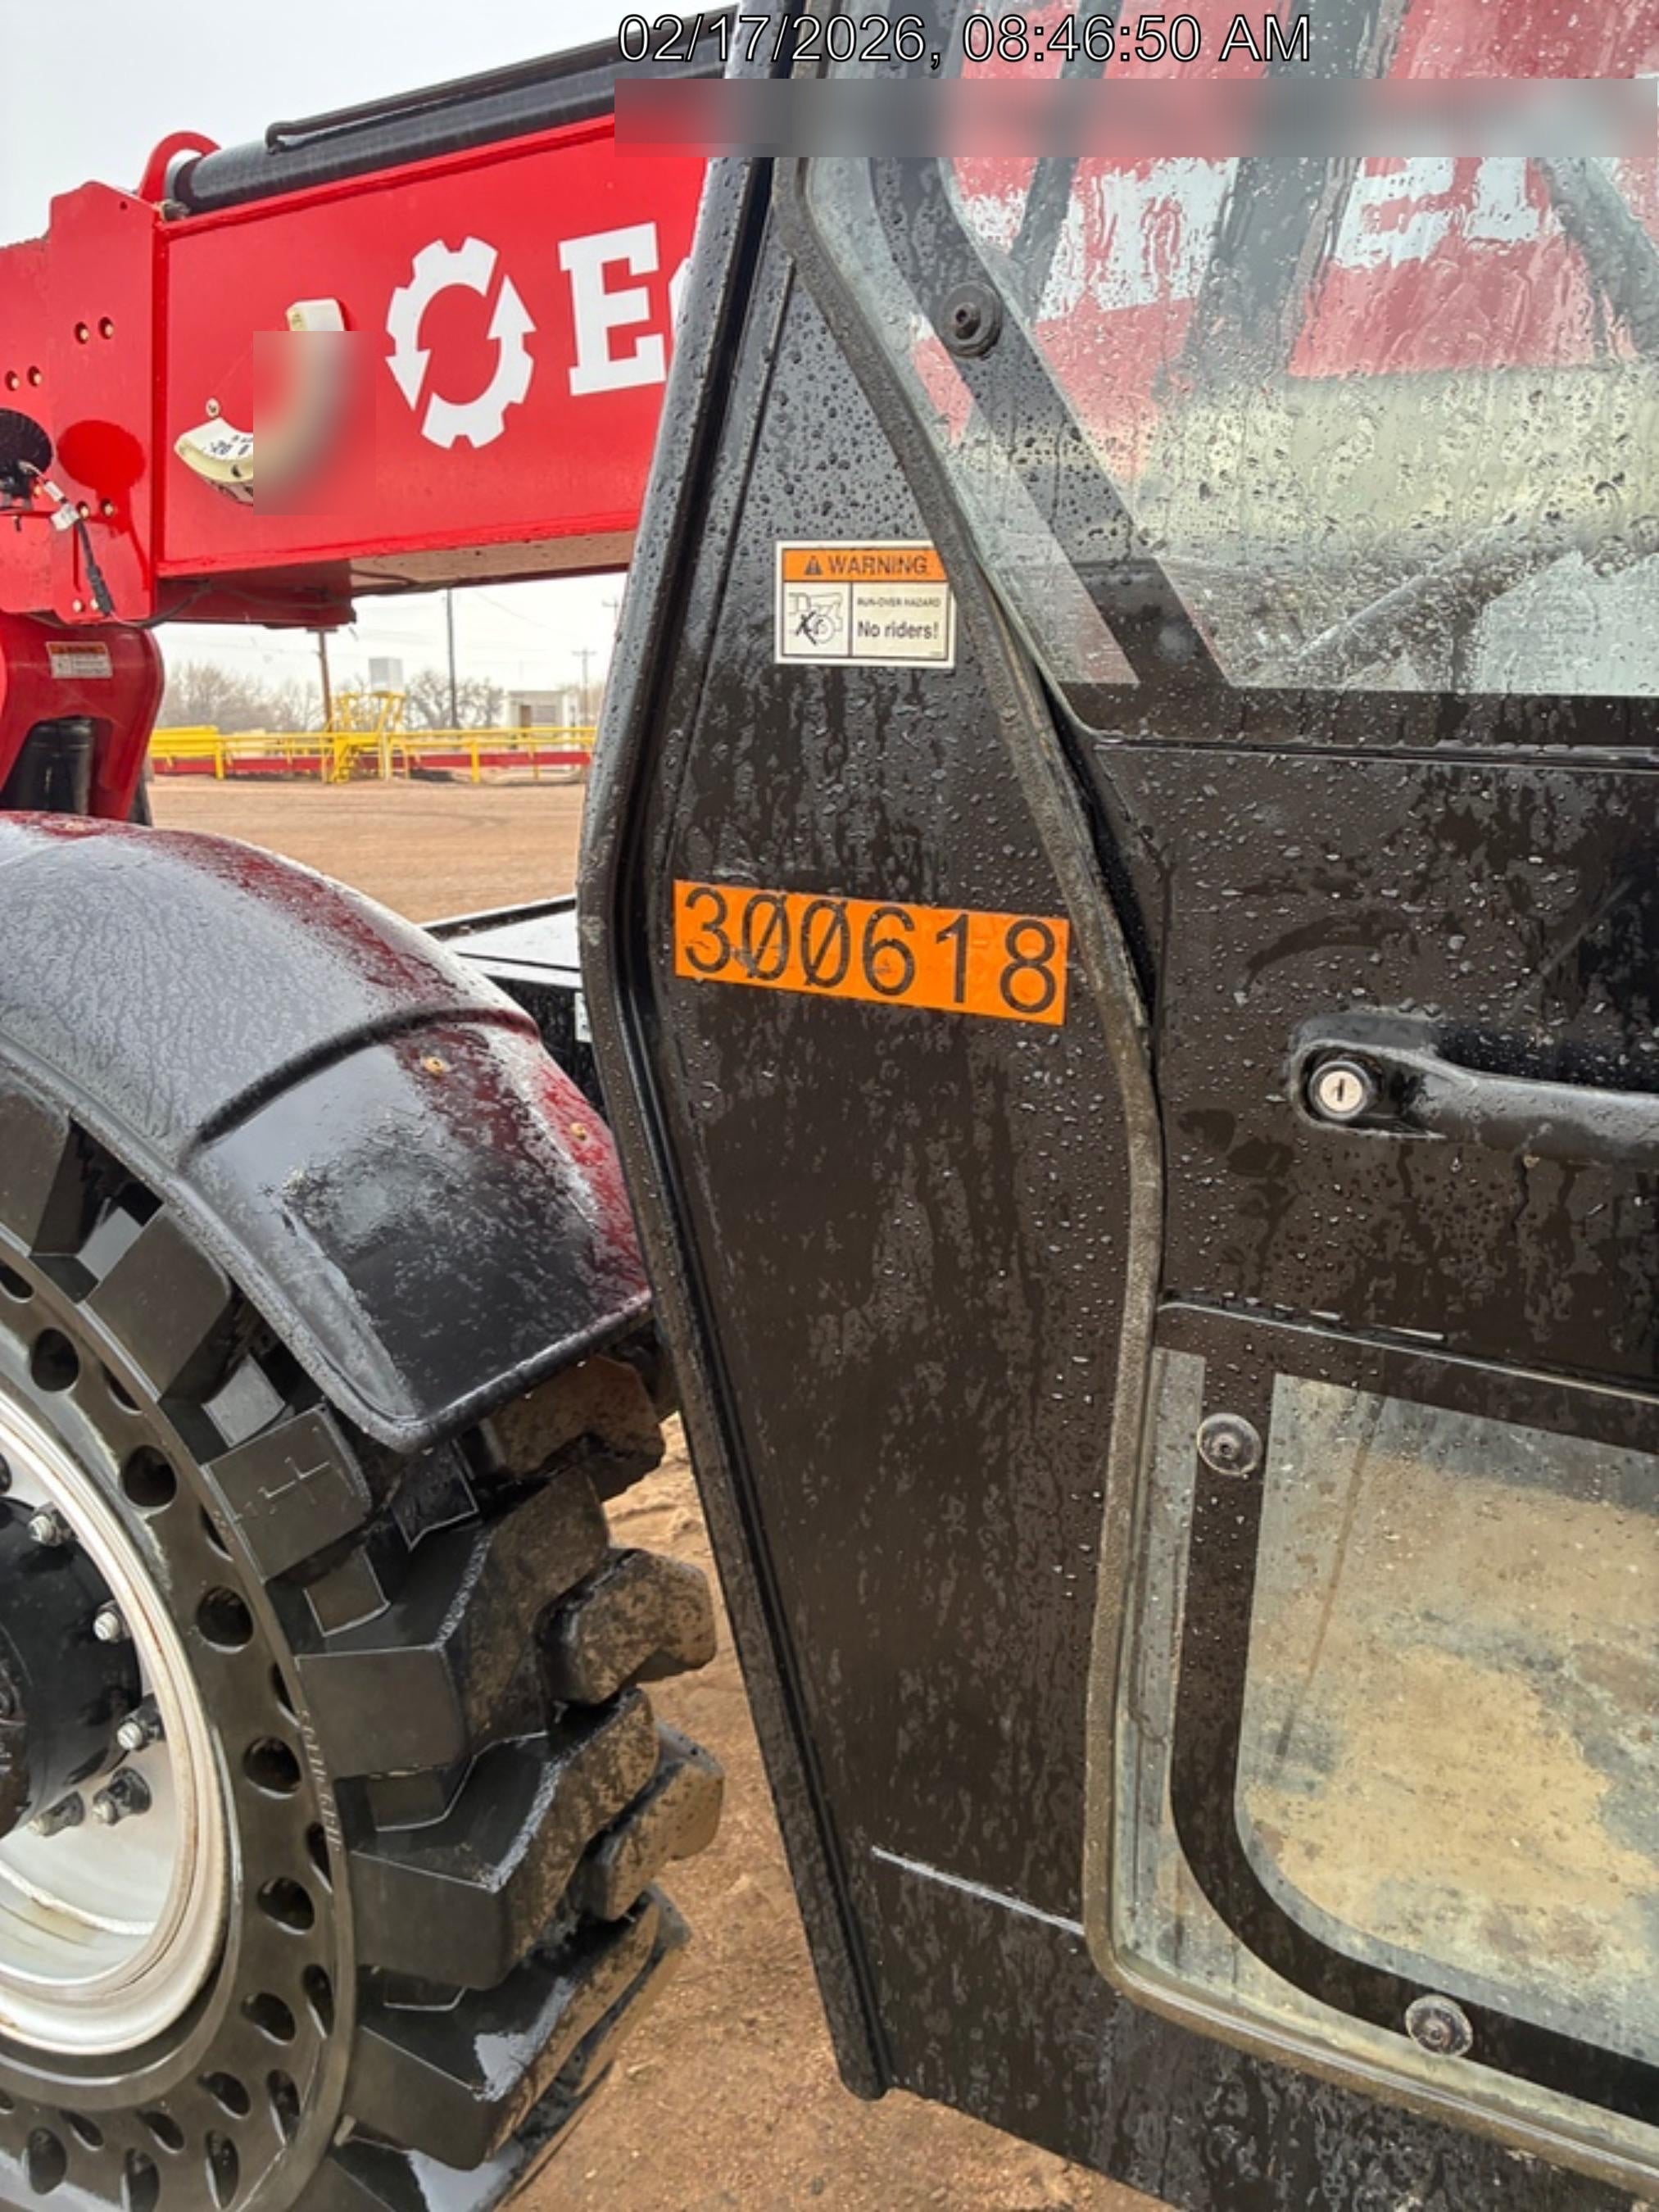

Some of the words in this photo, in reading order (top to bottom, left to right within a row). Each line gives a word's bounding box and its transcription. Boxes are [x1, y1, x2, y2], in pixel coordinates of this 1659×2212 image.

[828, 555, 927, 574] WARNING
[904, 597, 941, 608] HAZARD
[857, 621, 880, 637] No
[884, 621, 940, 640] riders!
[684, 886, 1057, 1014] 300618
